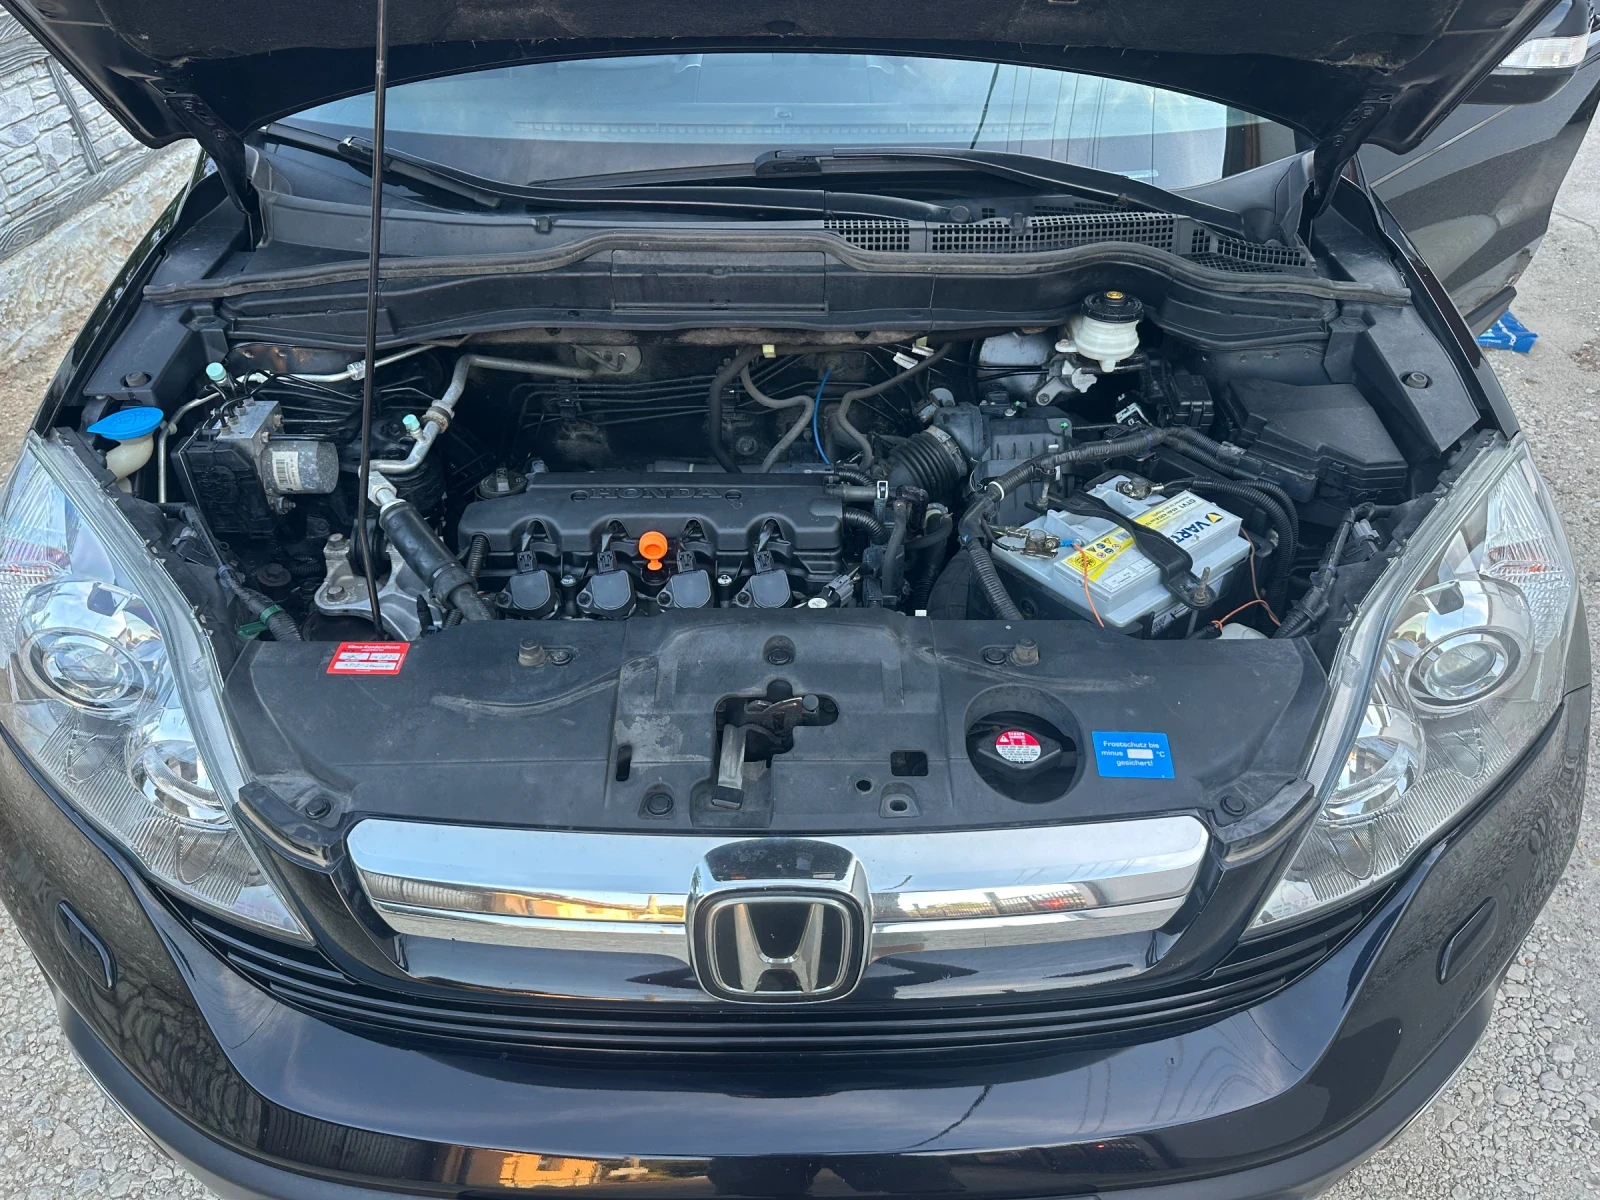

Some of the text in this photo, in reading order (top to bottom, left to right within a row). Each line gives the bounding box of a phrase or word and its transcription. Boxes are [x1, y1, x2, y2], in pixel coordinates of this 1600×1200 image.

[589, 487, 722, 499] HONDA
[1170, 521, 1211, 544] VART
[1103, 740, 1147, 748] Frostschutz
